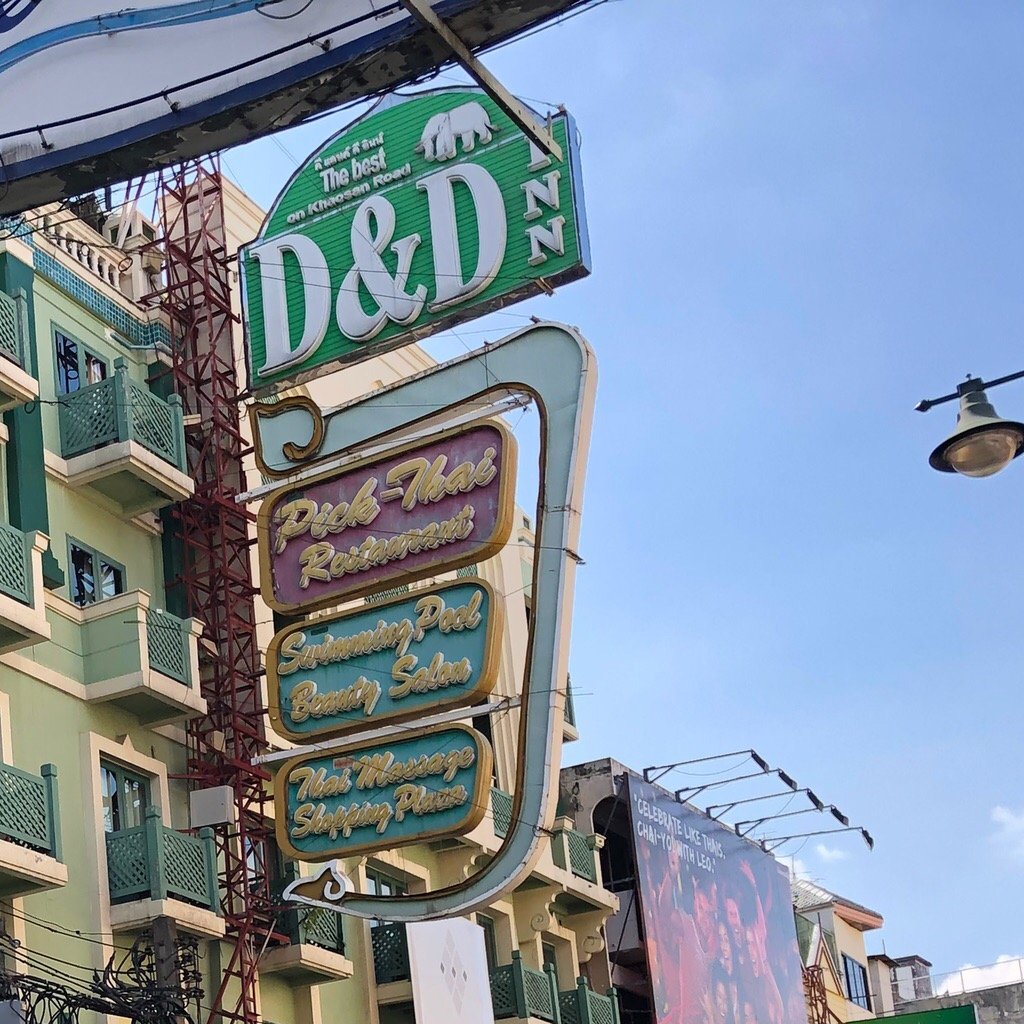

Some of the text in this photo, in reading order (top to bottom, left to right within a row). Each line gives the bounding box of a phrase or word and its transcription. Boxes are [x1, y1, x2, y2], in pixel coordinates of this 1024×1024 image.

[286, 162, 412, 224] on Khaosan Road
[319, 146, 387, 193] The best
[249, 162, 509, 378] D&D
[297, 503, 476, 590] Restaurant
[277, 590, 483, 676] Swimming Pool
[290, 651, 473, 724] Beauty Salon
[289, 745, 475, 801] Thai Massage
[290, 782, 469, 841] Shopping Plaza
[683, 822, 702, 847] LIKE
